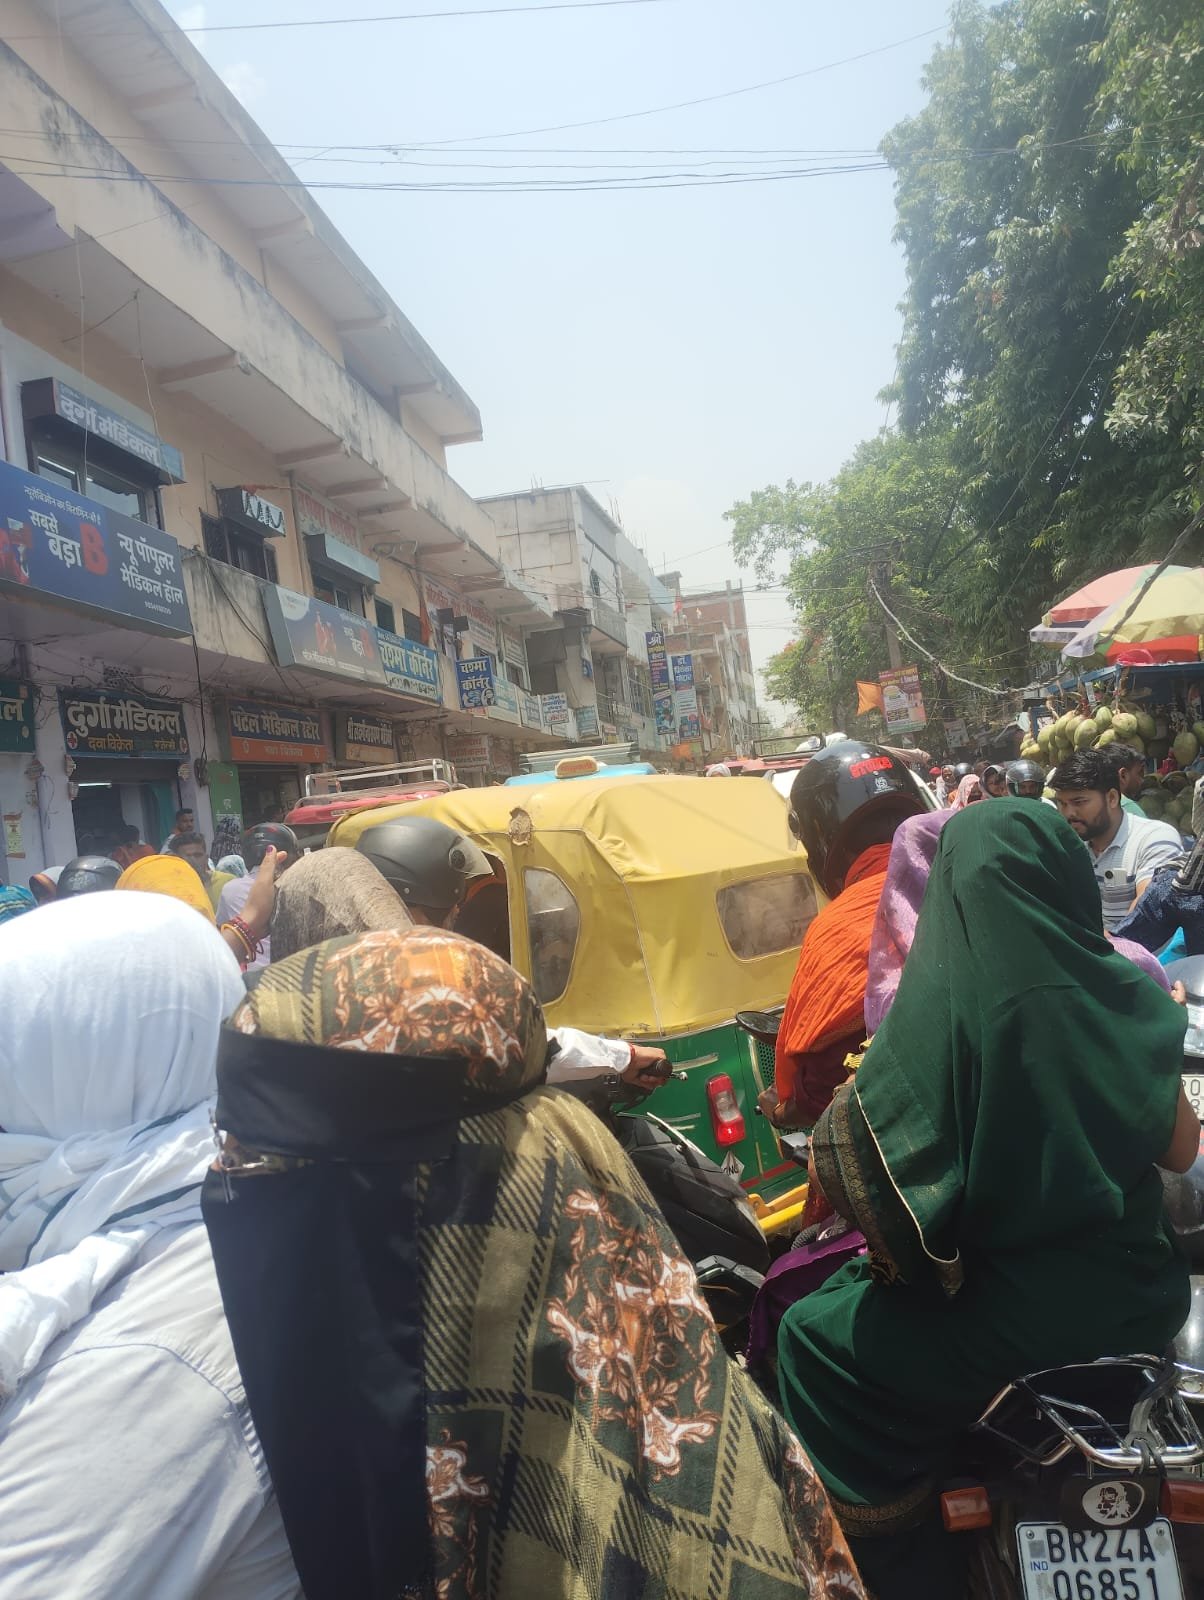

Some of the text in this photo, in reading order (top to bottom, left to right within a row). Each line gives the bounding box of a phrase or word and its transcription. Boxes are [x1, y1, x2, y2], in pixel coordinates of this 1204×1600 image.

[27, 507, 59, 535] सबसे
[44, 529, 82, 569] बड़ा
[79, 520, 109, 576] B
[117, 531, 176, 576] न्यू पॉपुलर
[119, 562, 184, 606] मेडिकल हॉल
[65, 695, 181, 738] दुर्गा मेडिकल
[231, 705, 260, 734] पटेल
[260, 710, 301, 739] मेडिकल
[87, 736, 108, 751] दवा
[1046, 1528, 1156, 1563] BR24A
[1053, 1567, 1160, 1600] 06851
